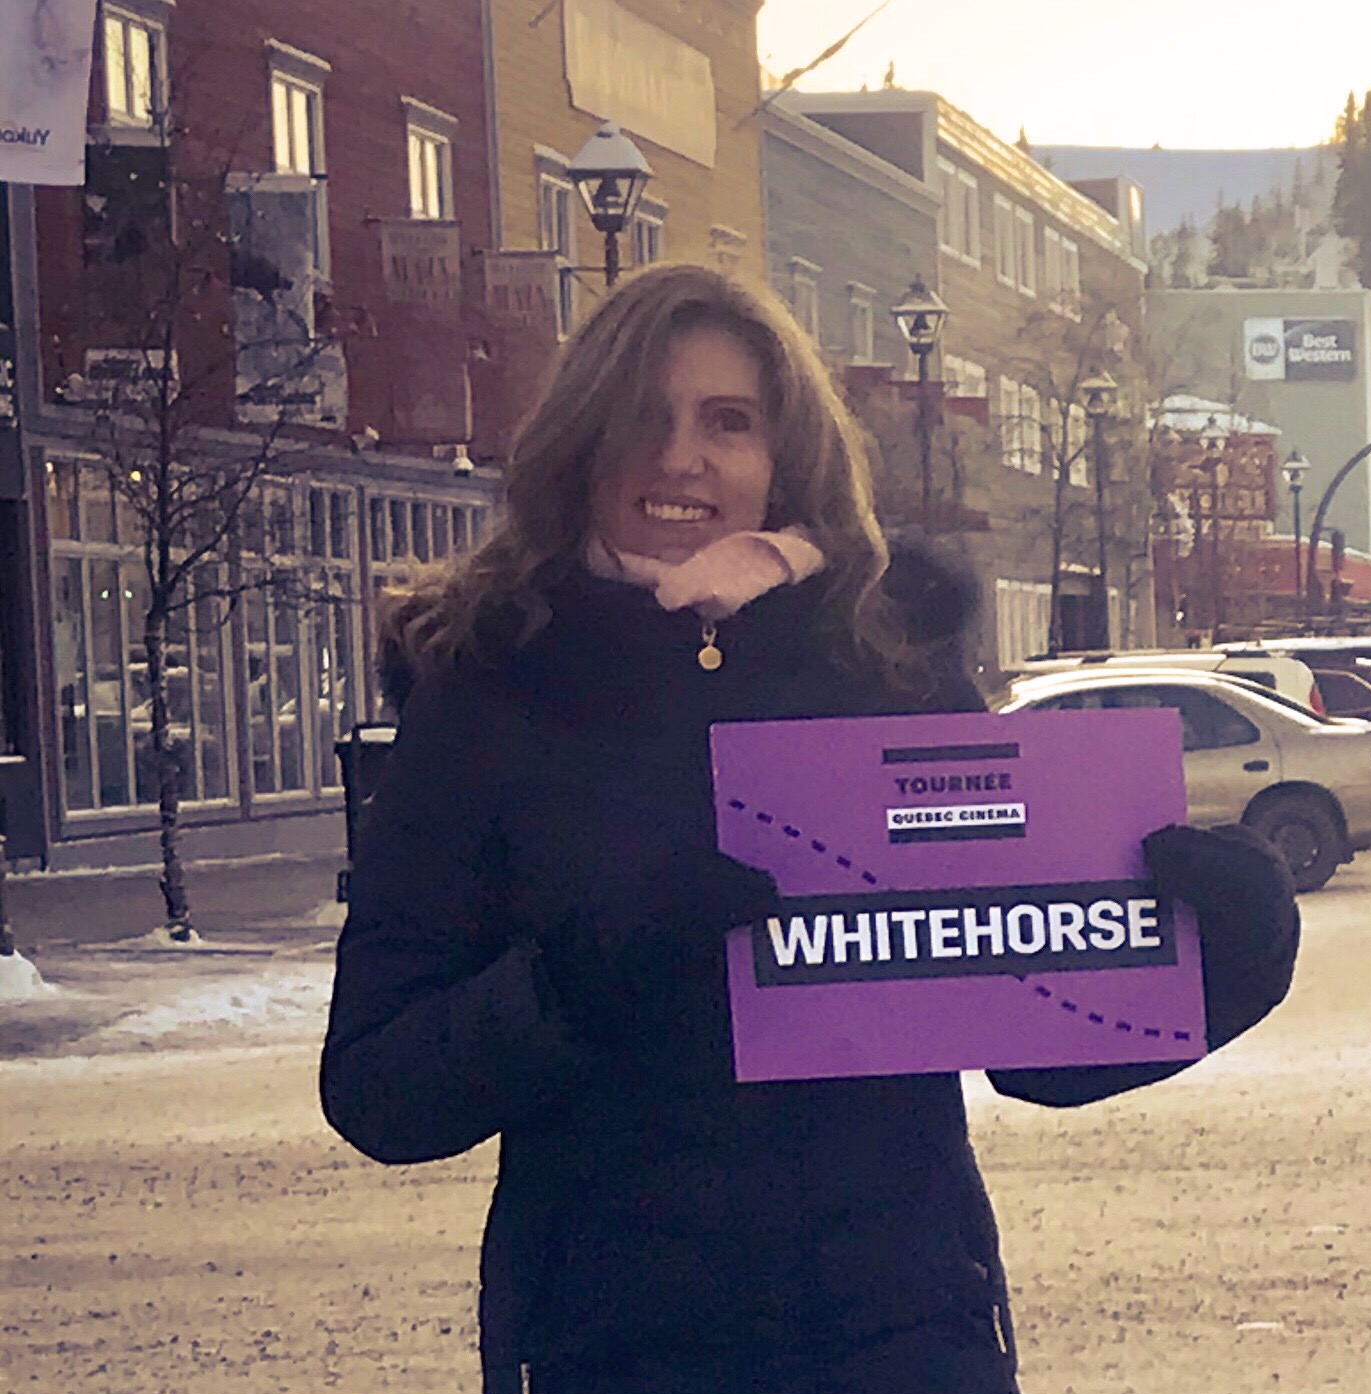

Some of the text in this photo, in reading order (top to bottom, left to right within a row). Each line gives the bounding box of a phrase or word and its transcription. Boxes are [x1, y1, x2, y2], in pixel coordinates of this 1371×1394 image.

[1302, 334, 1337, 348] Best
[1287, 347, 1351, 362] Western
[767, 898, 1161, 967] WHITEHORSE
